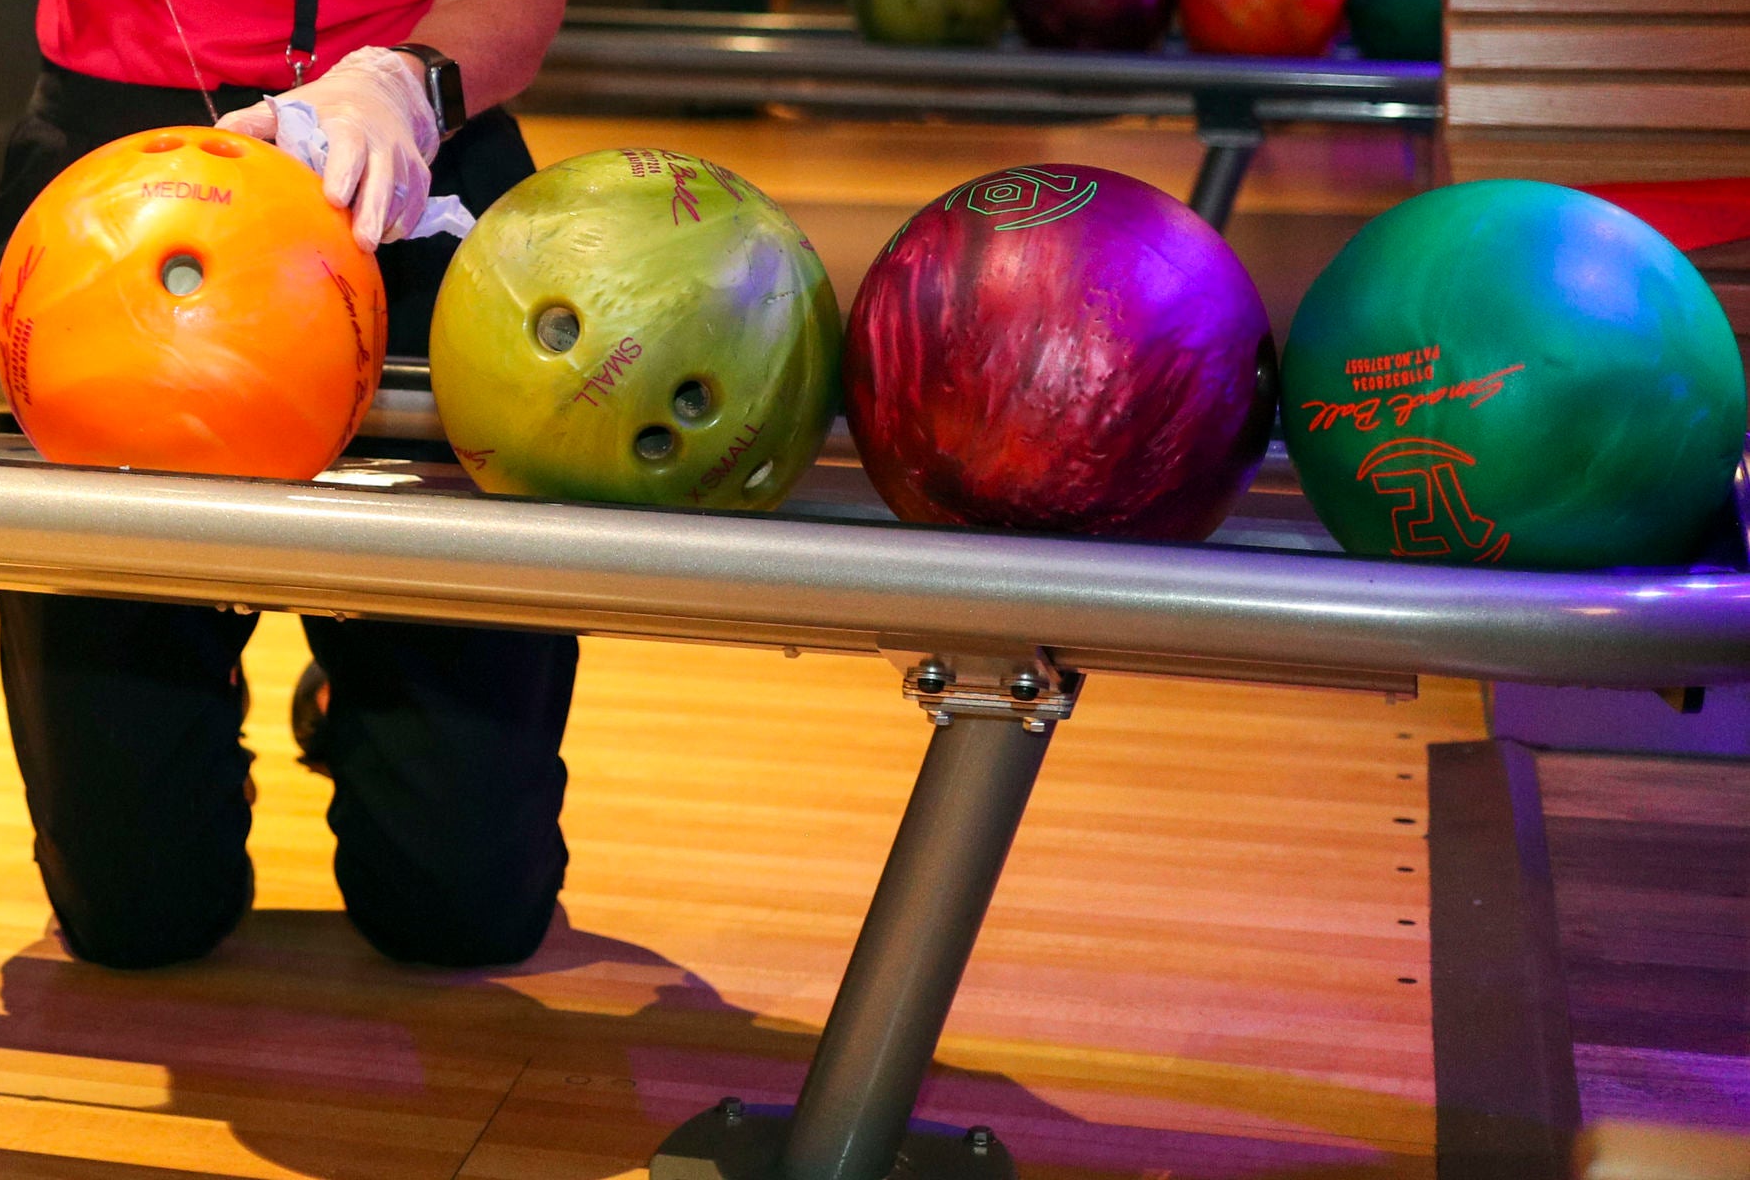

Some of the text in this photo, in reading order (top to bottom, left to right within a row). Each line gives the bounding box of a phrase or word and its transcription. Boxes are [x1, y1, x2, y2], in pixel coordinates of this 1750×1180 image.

[141, 181, 233, 206] MEDIUM
[574, 336, 643, 408] SMALL
[1301, 397, 1381, 432] Ball
[699, 421, 767, 489] SMALL
